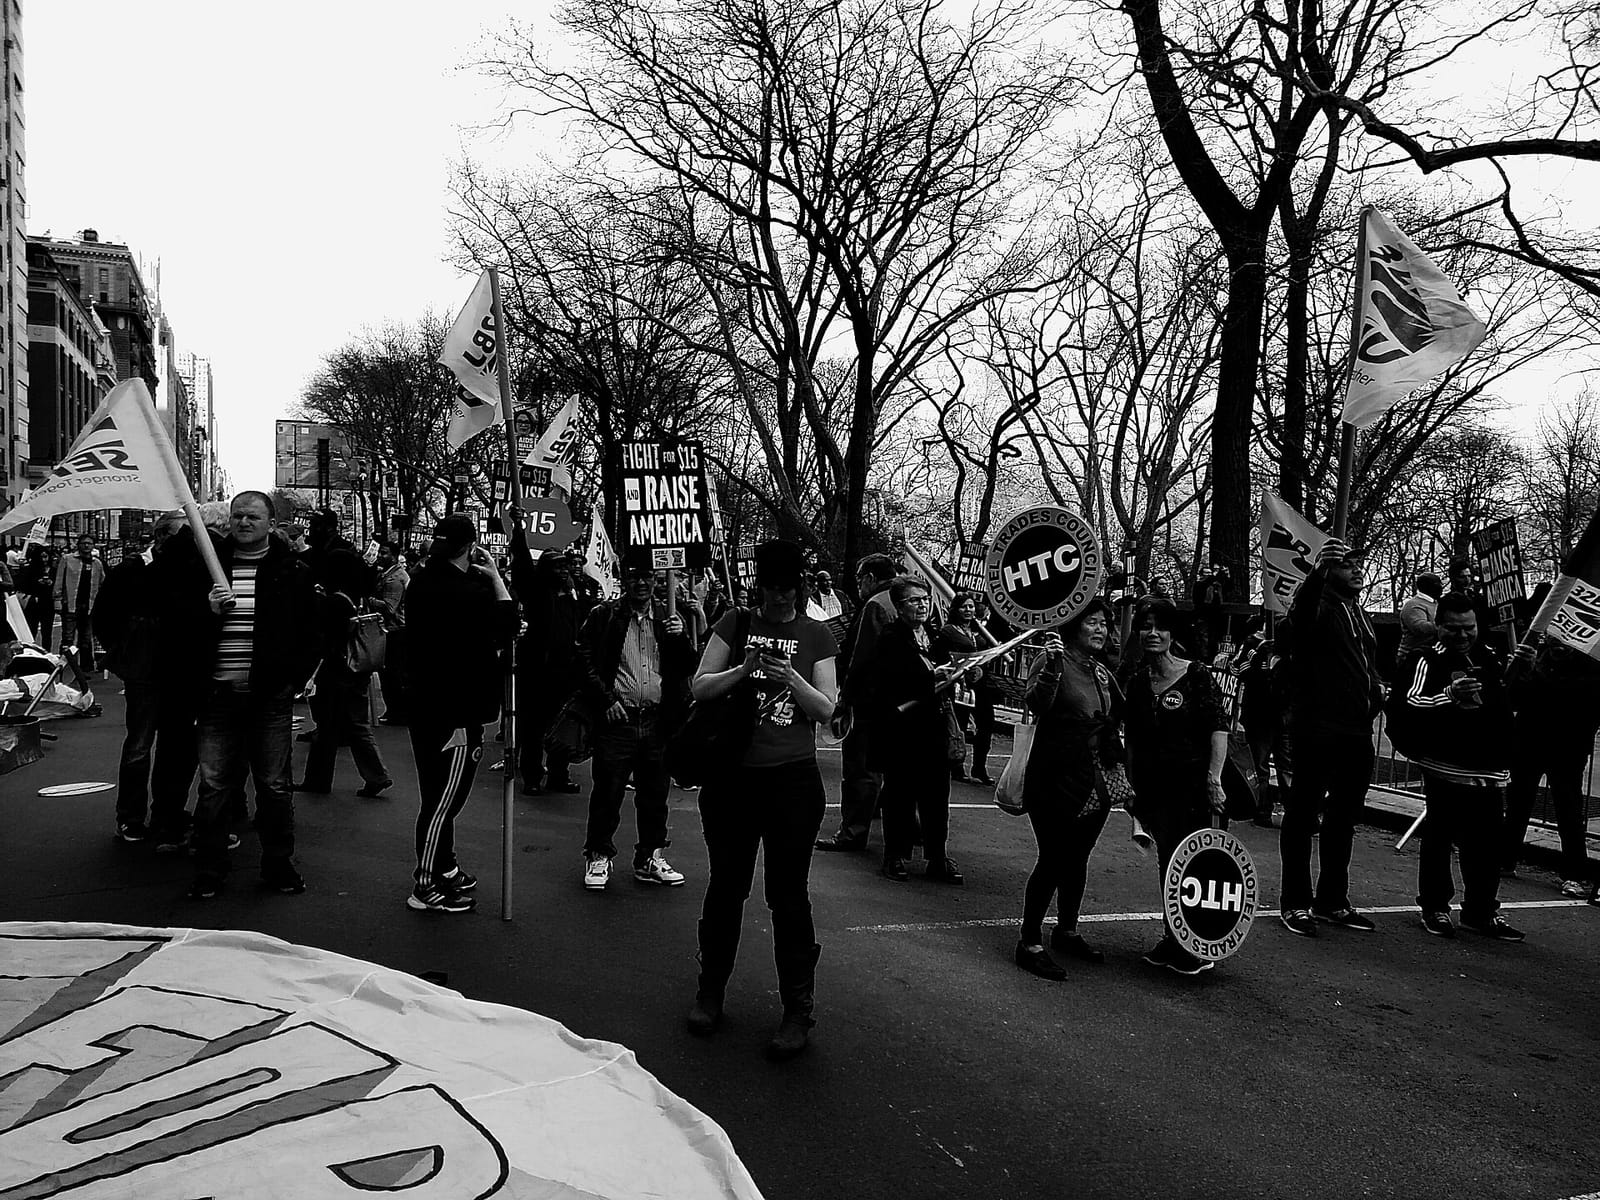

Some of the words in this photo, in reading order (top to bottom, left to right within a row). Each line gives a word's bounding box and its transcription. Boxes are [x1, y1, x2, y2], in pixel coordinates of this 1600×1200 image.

[621, 442, 660, 470] FIGHT
[663, 451, 676, 463] FOR
[677, 443, 699, 471] $15
[626, 490, 639, 501] AND
[644, 474, 701, 511] RAISE
[629, 512, 704, 546] AMERICA
[993, 510, 1051, 554] TRADES
[1056, 513, 1097, 582] COUNCIL
[1003, 543, 1080, 592] HTC
[989, 560, 1014, 615] HOTEL
[1018, 591, 1085, 626] AFL-CIO
[1552, 613, 1598, 639] SEIU
[776, 638, 799, 654] THE
[1188, 833, 1244, 857] AFL-CIO
[1168, 858, 1189, 941] COUNCIL
[1181, 876, 1243, 912] HTC
[1240, 862, 1256, 923] HOTEL
[1191, 928, 1244, 957] TRADES
